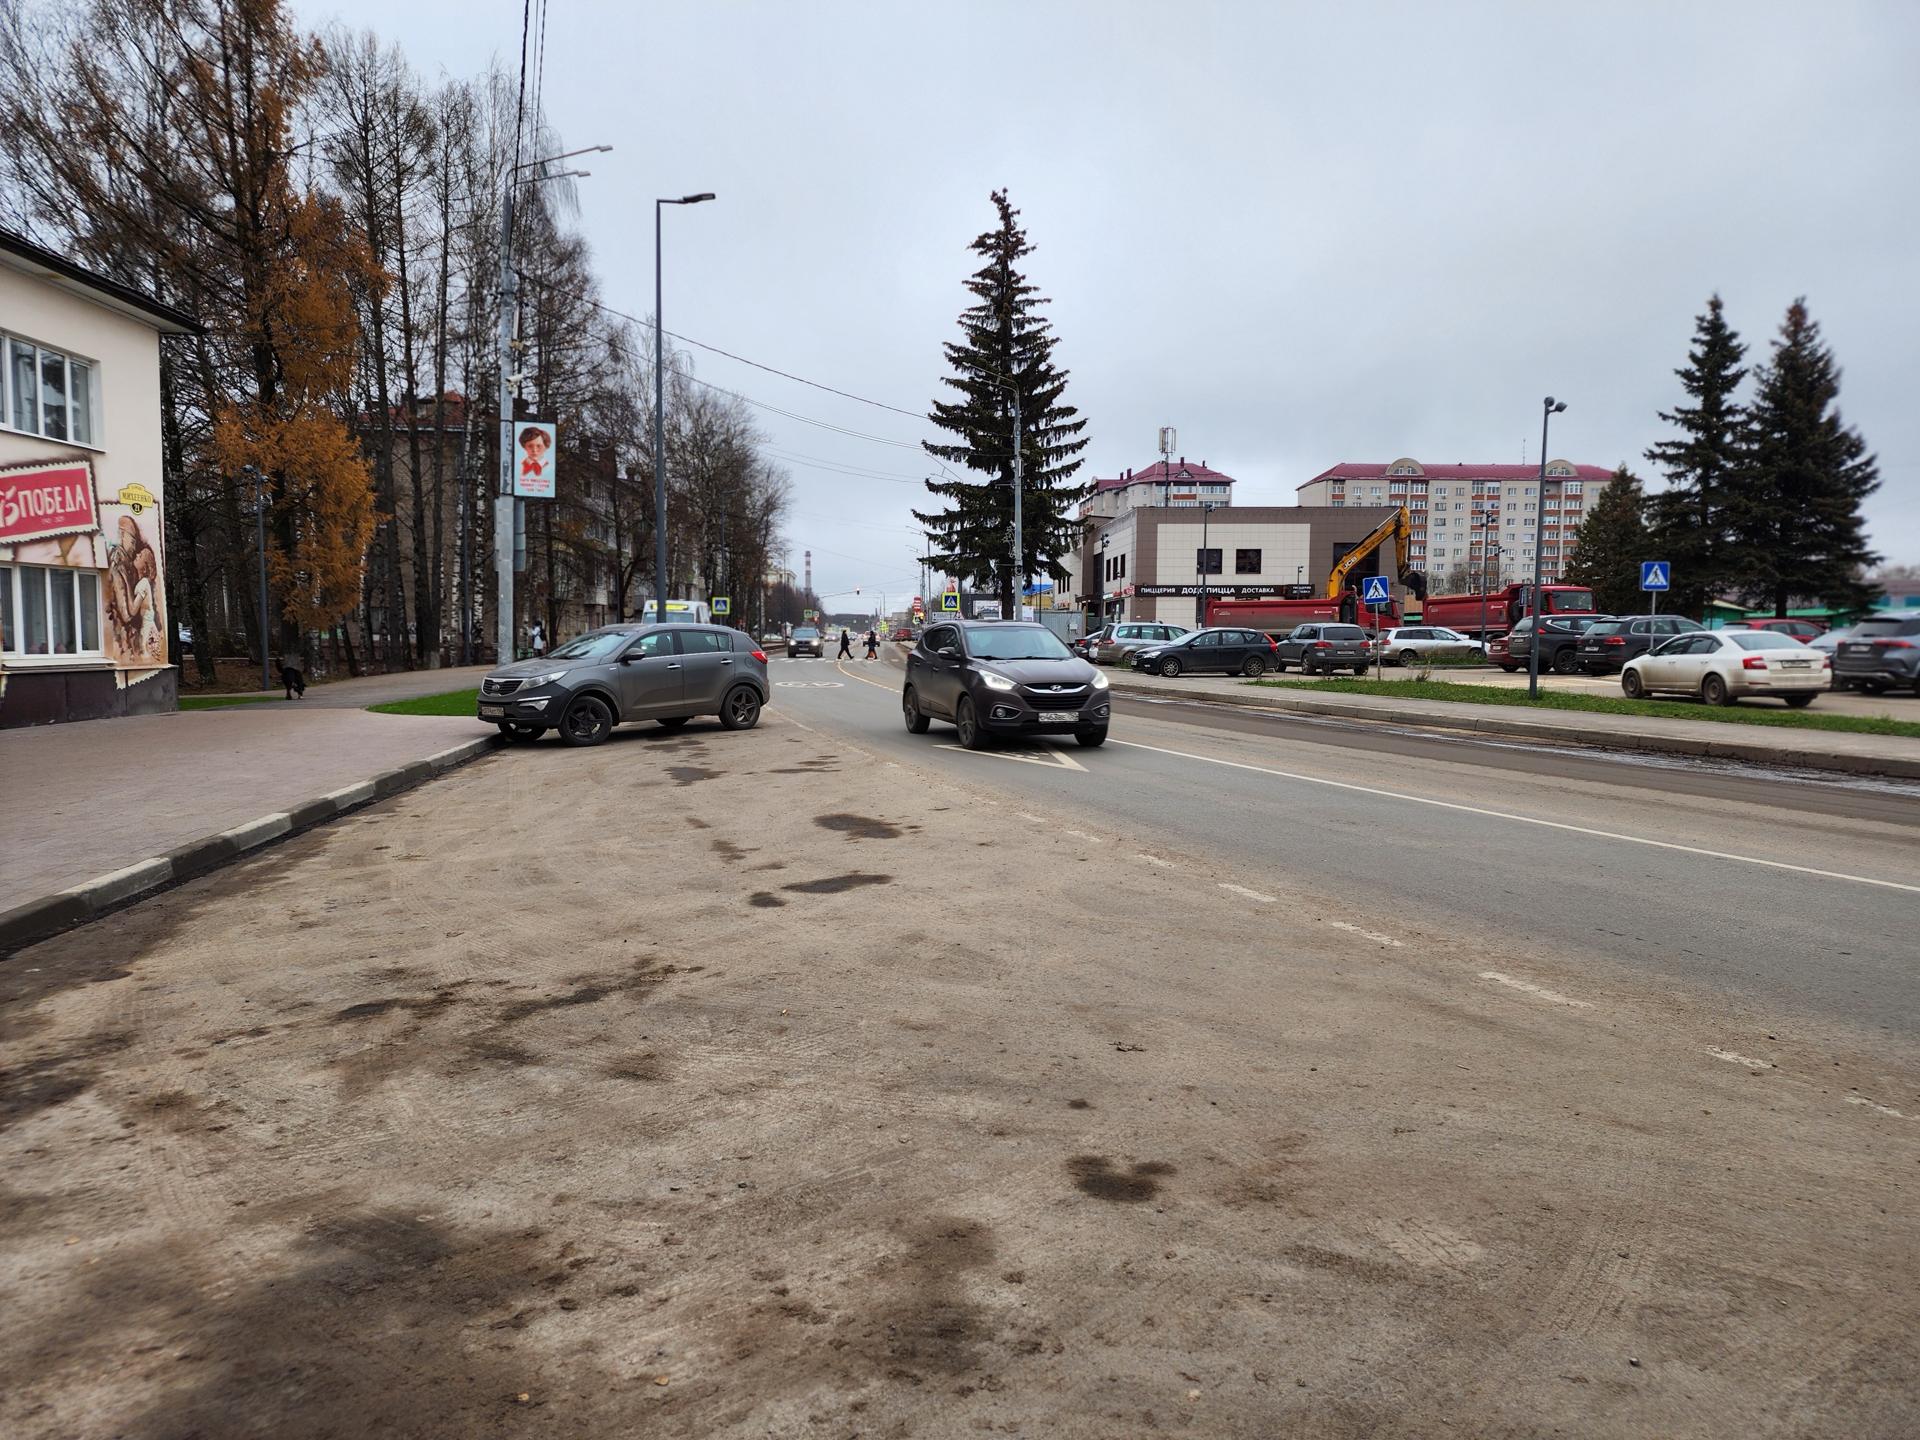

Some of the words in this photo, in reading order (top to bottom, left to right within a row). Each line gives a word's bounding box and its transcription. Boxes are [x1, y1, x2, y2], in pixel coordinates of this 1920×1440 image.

[18, 484, 87, 518] ПОБЕДА
[1342, 556, 1358, 570] JCB
[1206, 586, 1236, 594] ПИЦЦА
